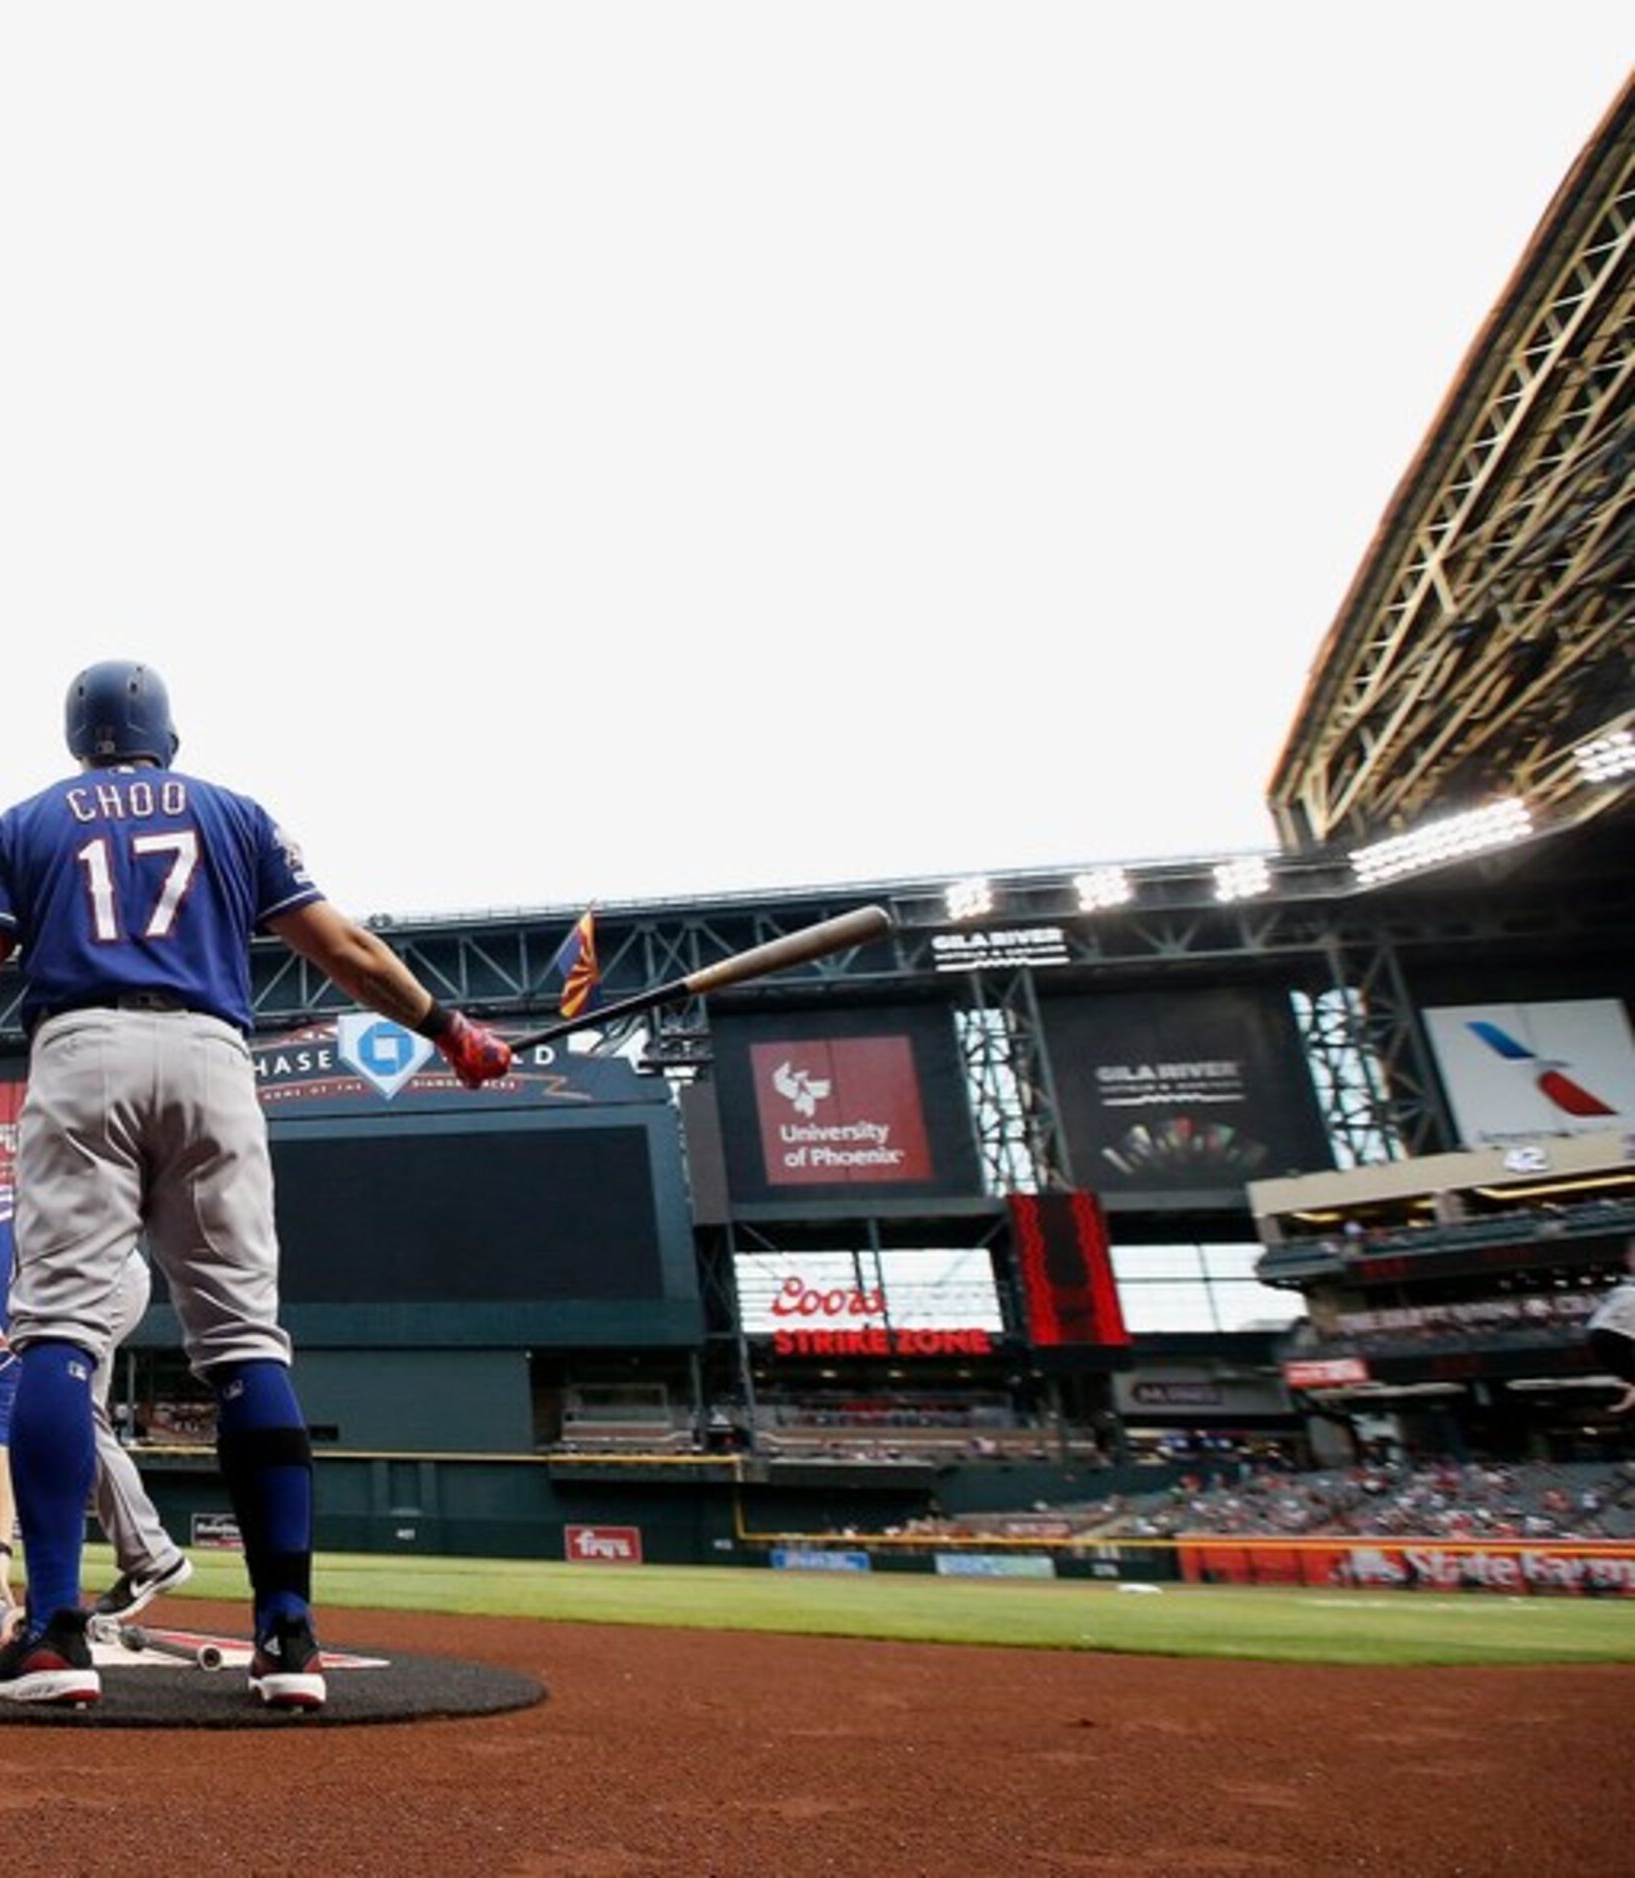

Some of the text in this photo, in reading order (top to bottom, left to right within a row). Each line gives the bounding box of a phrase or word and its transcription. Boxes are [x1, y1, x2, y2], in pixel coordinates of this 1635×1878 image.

[66, 781, 187, 823] CHOO
[77, 828, 202, 943] 17
[932, 927, 1064, 950] GILA RIVER
[254, 1050, 332, 1077] HASE
[1095, 1060, 1240, 1082] GILA RIVER
[780, 1121, 890, 1145] University
[784, 1146, 902, 1168] of Phoenix
[771, 1276, 888, 1317] Coors
[772, 1328, 992, 1356] STRIKE ZONE
[1406, 1547, 1635, 1588] State Farm
